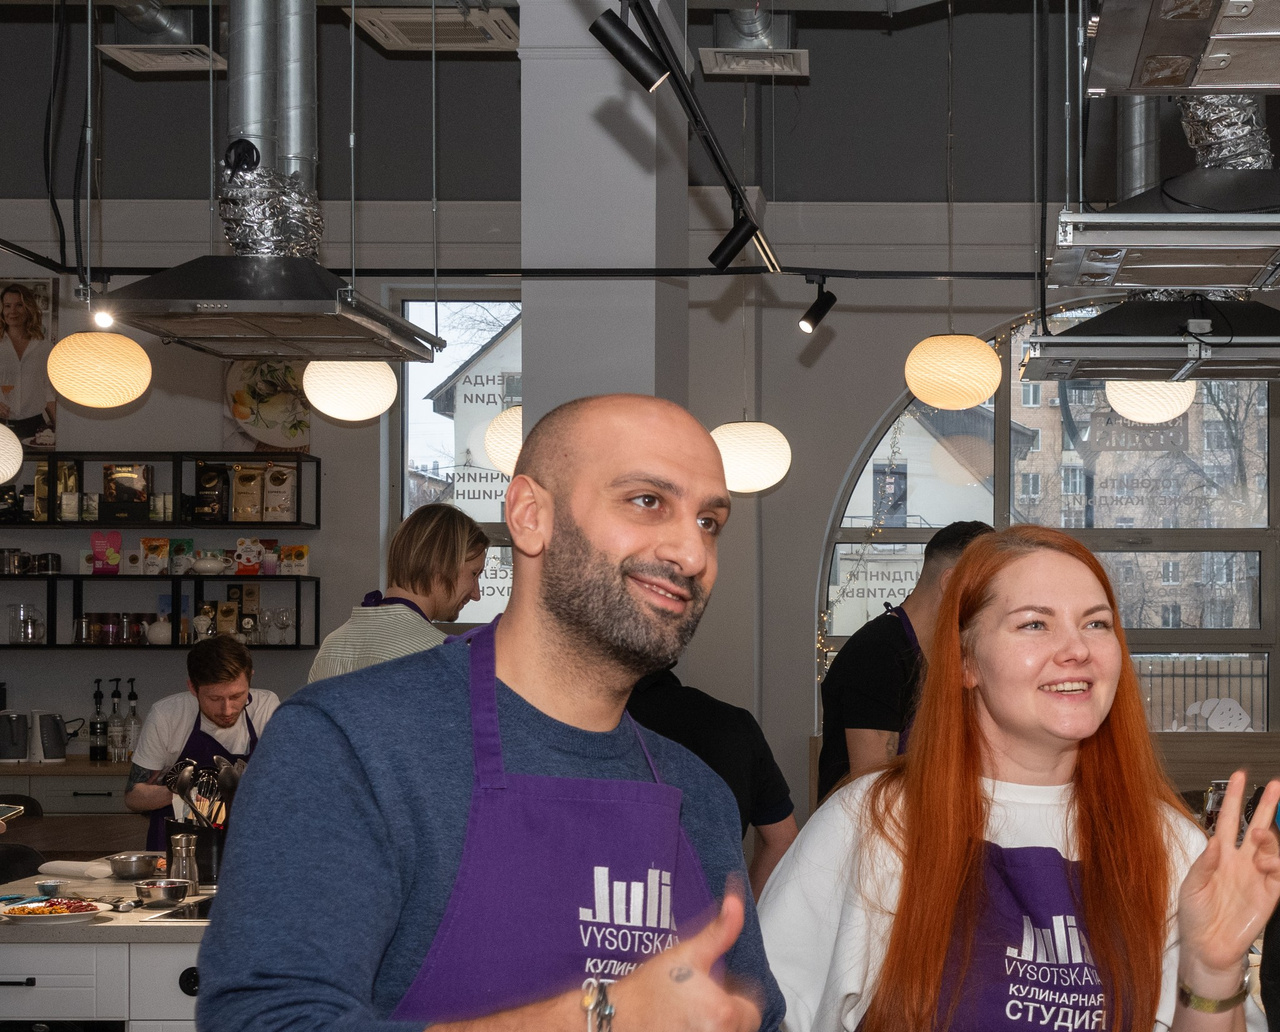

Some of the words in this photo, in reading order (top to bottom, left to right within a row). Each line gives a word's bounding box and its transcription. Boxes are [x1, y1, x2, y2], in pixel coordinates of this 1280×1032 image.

[579, 866, 677, 932] Juli
[585, 957, 644, 976] КУЛИН
[1008, 983, 1106, 1007] КУЛИНАРНАЯ
[1005, 1000, 1107, 1032] СТУДИЯ
